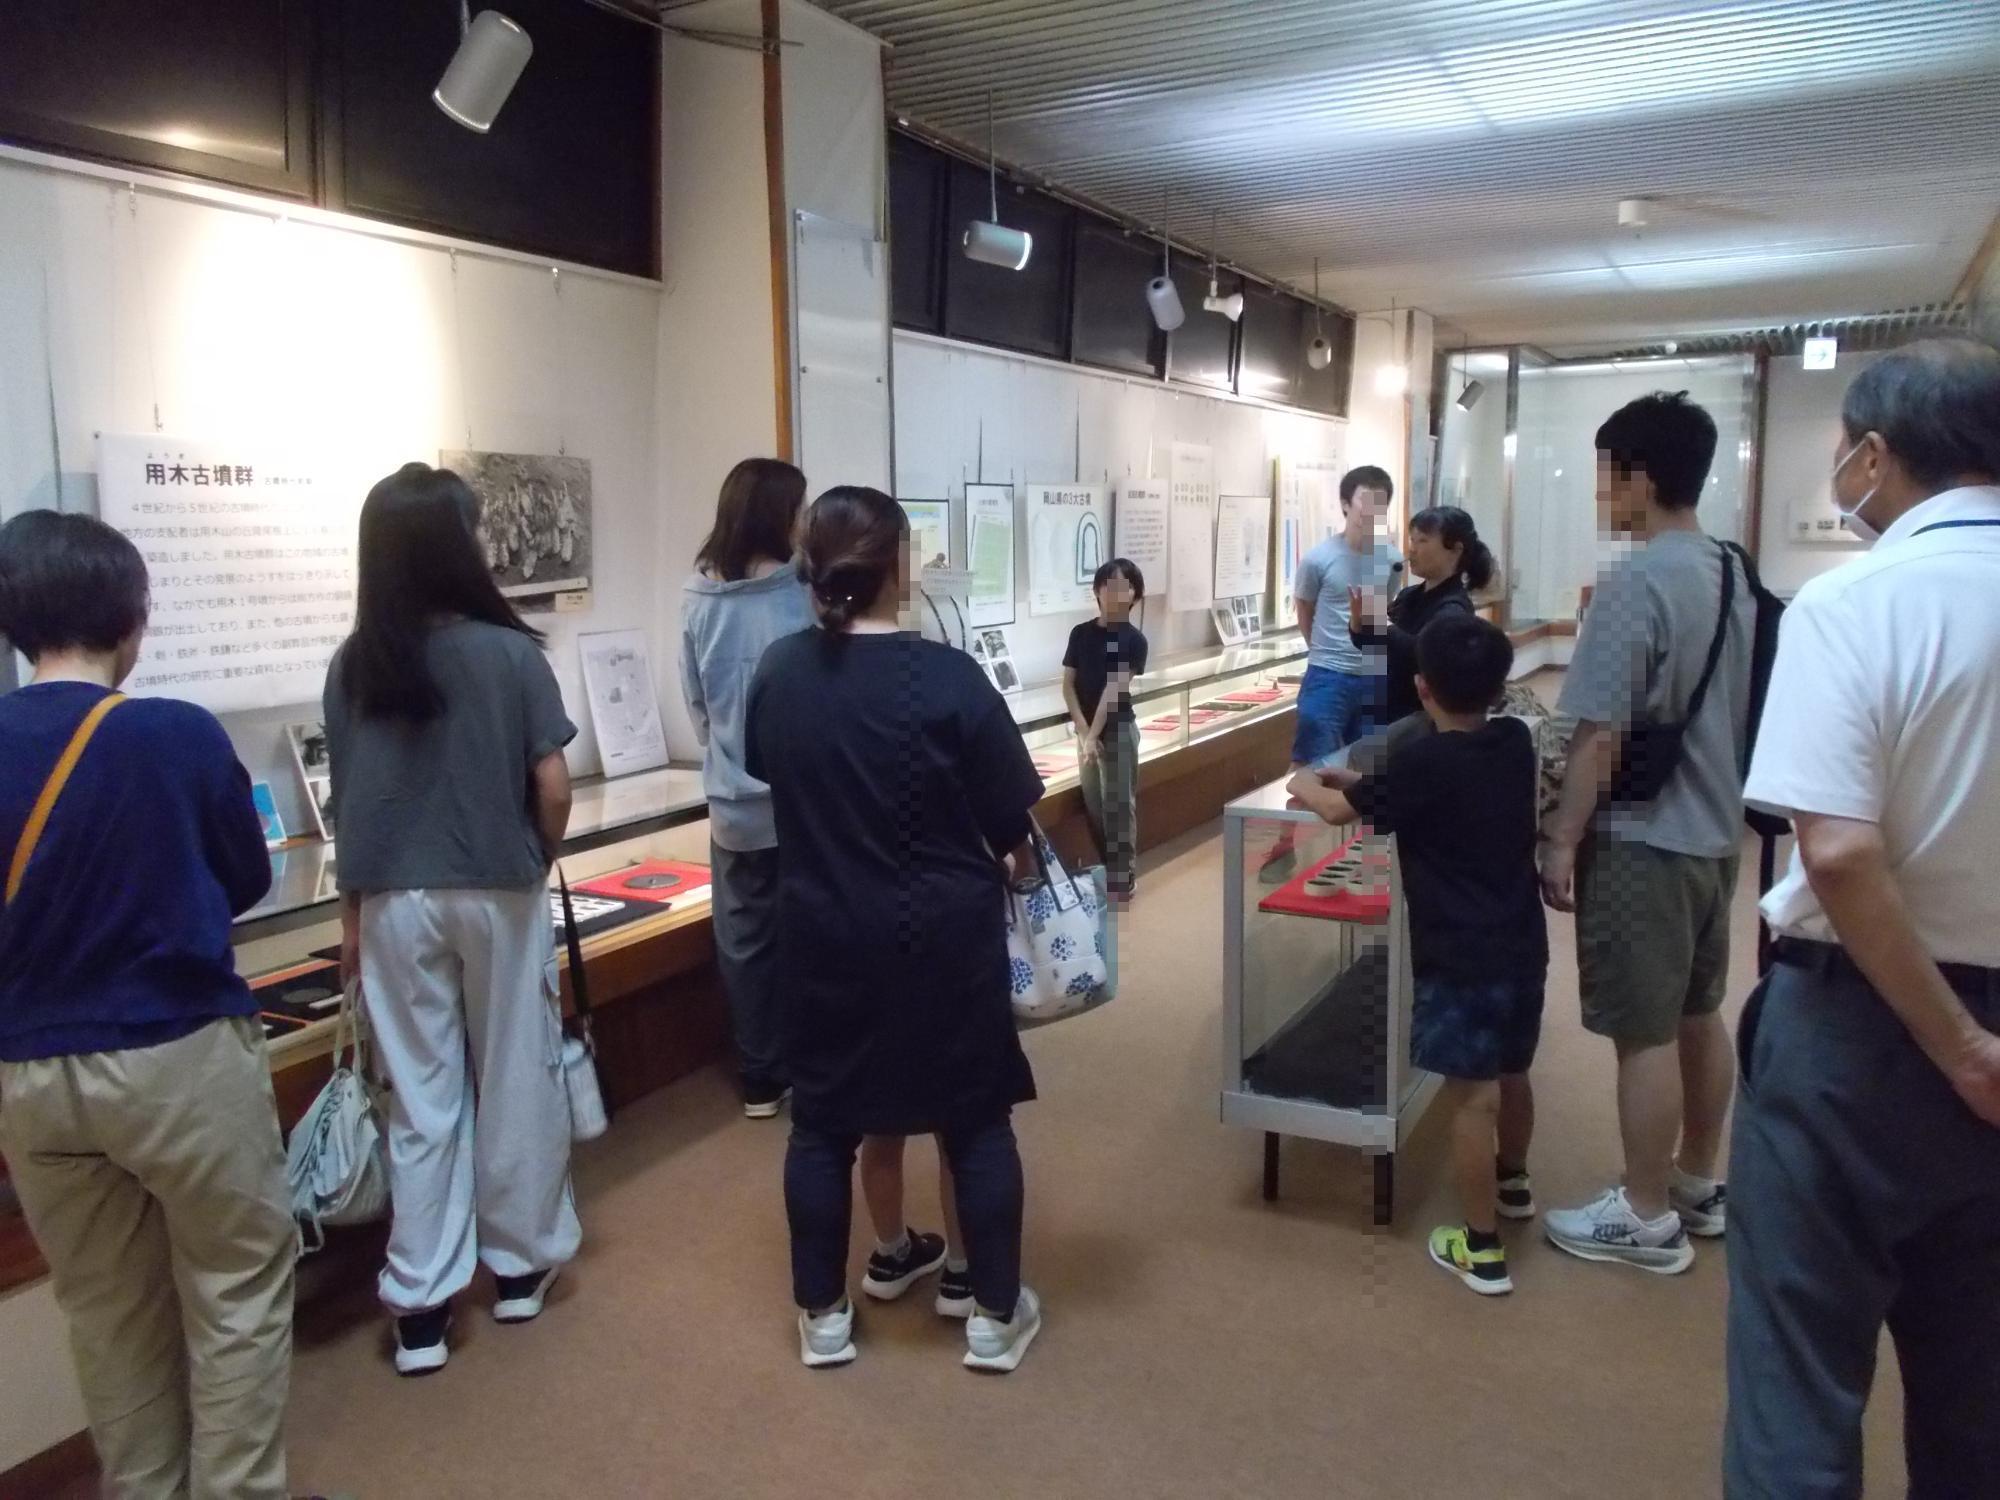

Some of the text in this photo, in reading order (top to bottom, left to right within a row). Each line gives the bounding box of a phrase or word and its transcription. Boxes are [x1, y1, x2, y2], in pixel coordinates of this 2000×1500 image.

[145, 463, 254, 487] 用木古墳群
